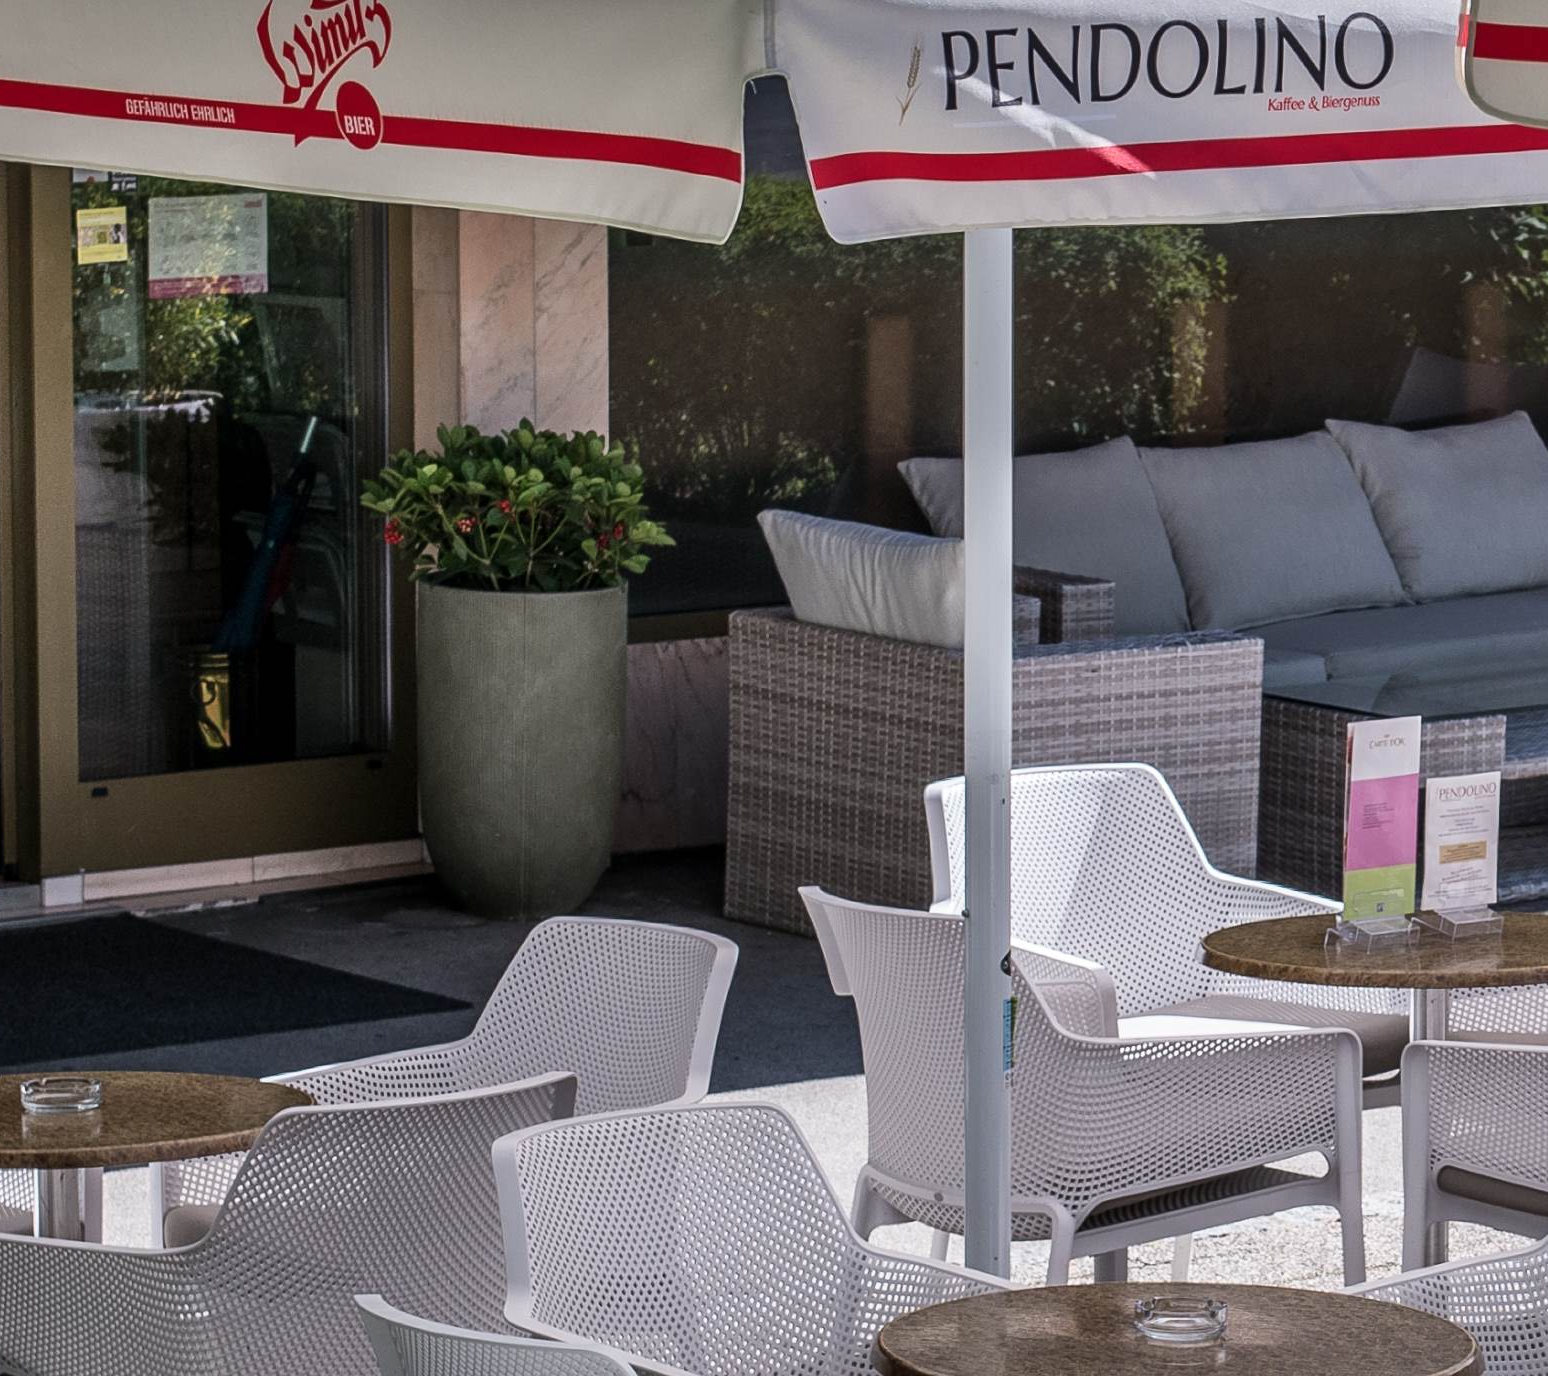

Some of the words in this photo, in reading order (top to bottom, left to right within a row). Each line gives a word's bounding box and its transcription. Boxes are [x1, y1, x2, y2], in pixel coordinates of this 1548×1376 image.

[941, 11, 1394, 111] PENDOLINO
[125, 96, 189, 120] GEFÄHRLICH
[191, 103, 236, 124] EHRLICH
[1267, 97, 1306, 111] Kaffee
[1308, 96, 1320, 111] &
[1321, 95, 1381, 112] Biergenuss
[344, 115, 375, 136] BIER
